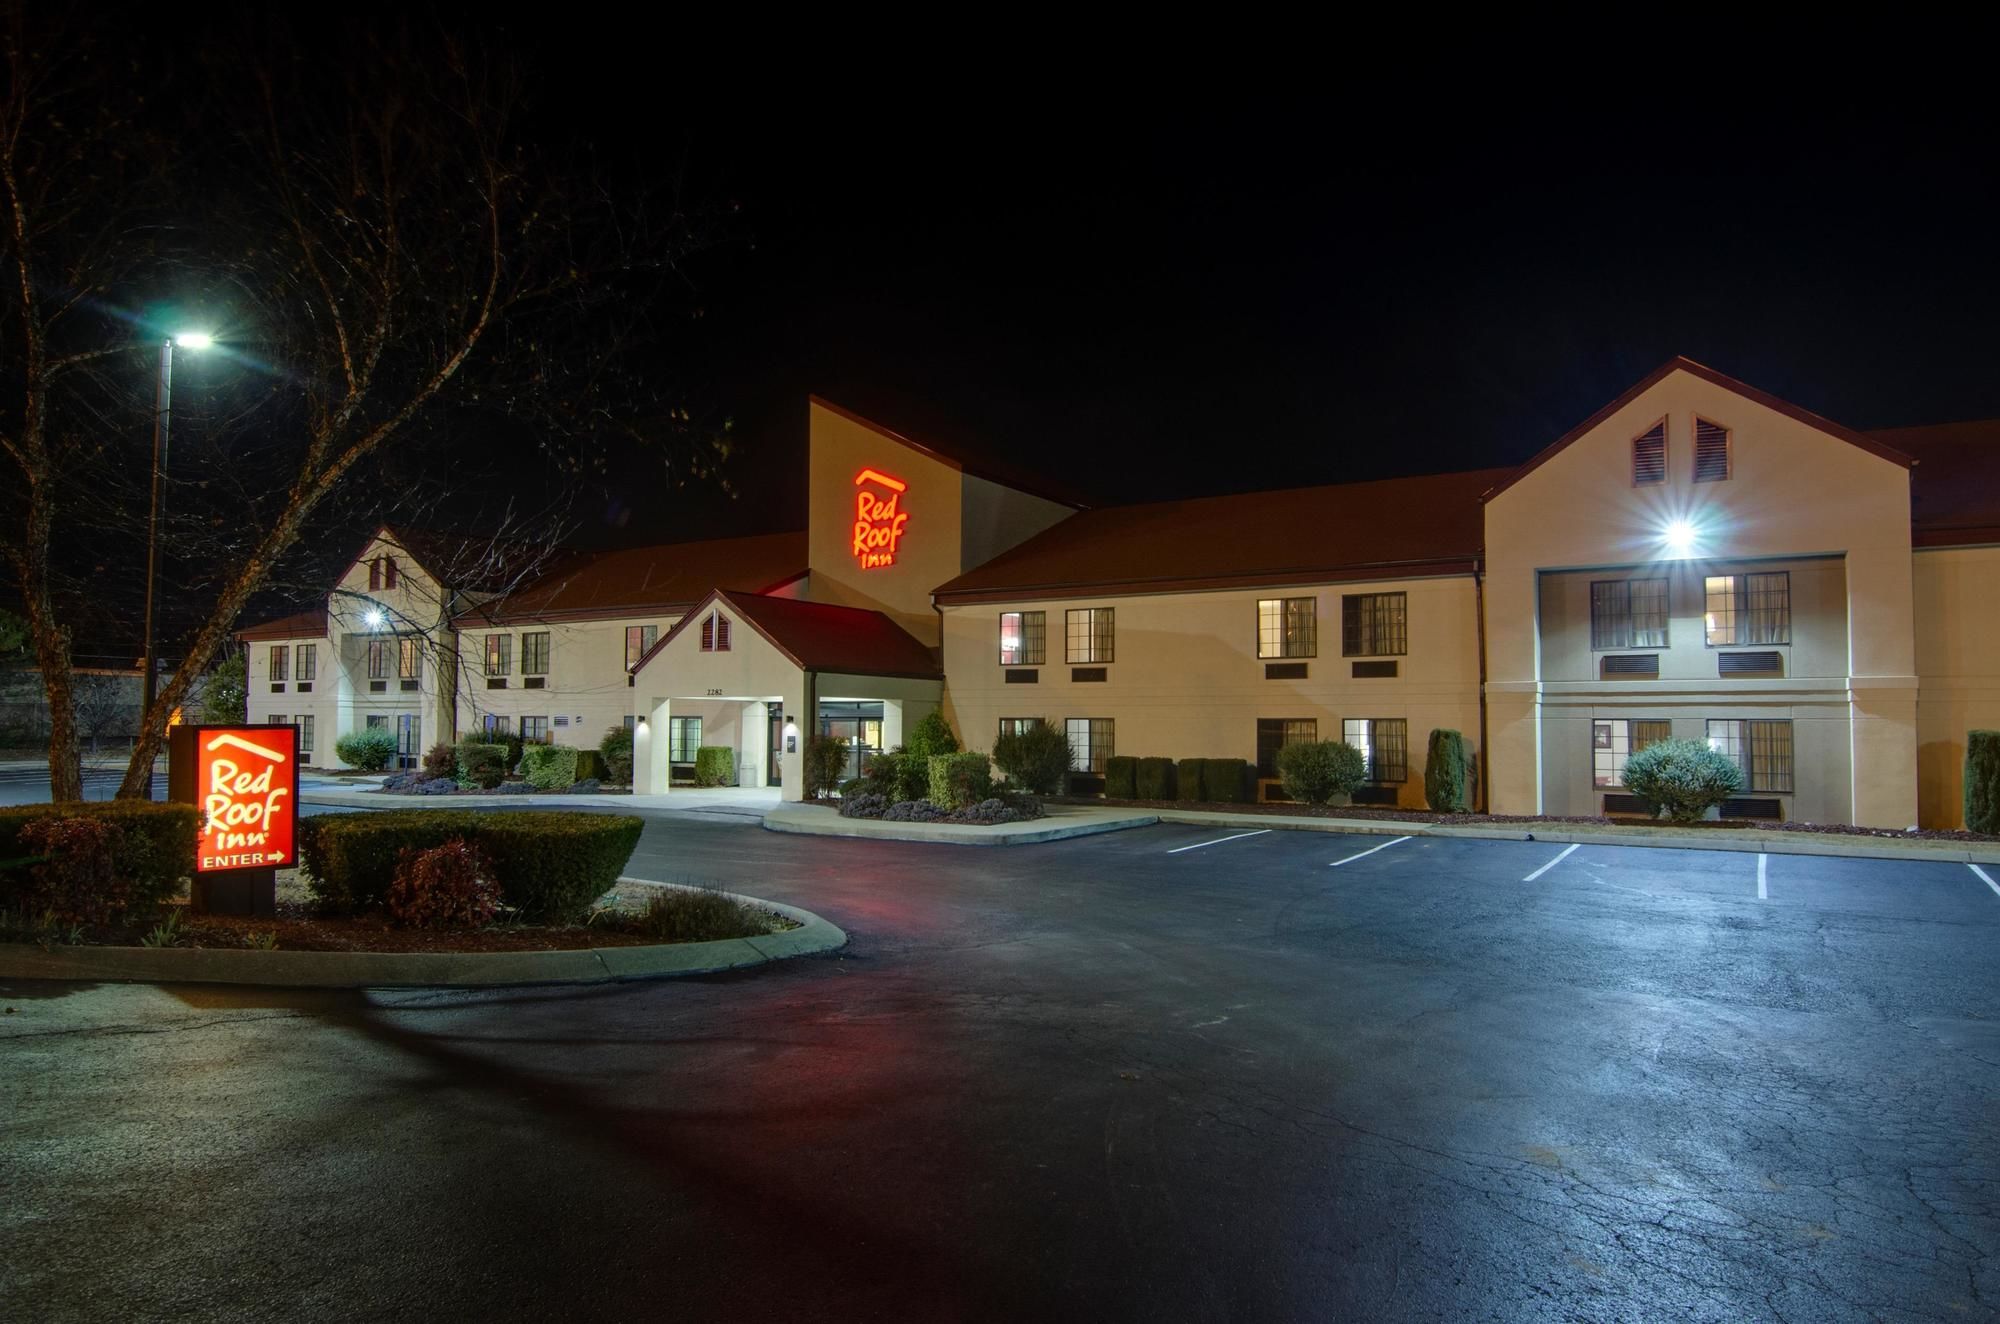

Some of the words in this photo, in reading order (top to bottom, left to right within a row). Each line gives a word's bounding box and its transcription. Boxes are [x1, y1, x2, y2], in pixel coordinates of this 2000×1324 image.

[858, 491, 898, 523] Red
[853, 513, 907, 556] Roof
[211, 759, 274, 796] Red
[204, 787, 288, 835] Roof
[203, 853, 264, 868] ENTER
